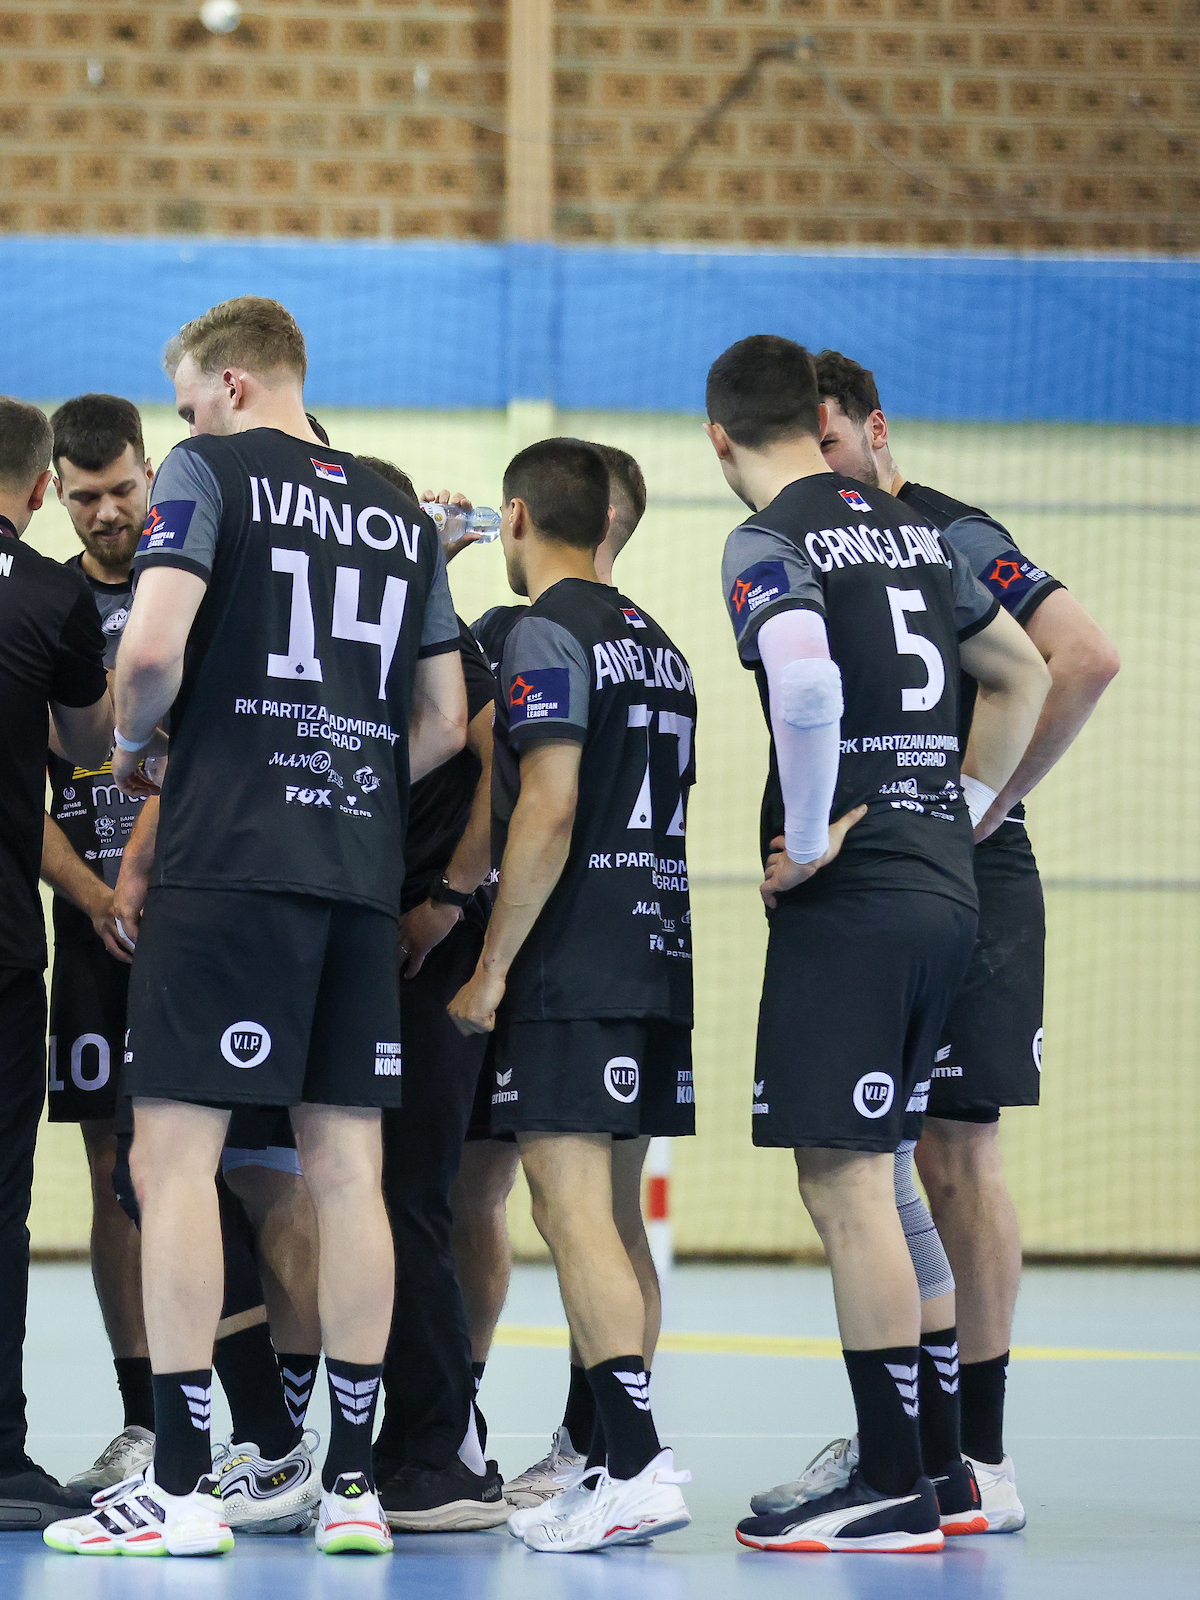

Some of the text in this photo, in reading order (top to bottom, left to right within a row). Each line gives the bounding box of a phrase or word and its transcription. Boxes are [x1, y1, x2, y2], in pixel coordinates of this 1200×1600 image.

[250, 475, 421, 564] IVANOV
[266, 547, 409, 701] 14
[886, 585, 946, 712] 5
[235, 698, 258, 715] RK
[261, 699, 328, 723] PARTIZA
[526, 702, 559, 711] EUROPEAN
[526, 709, 549, 719] LEAGUE
[296, 721, 362, 752] BEORAD
[862, 734, 925, 753] PARTIZAN
[896, 751, 947, 767] BEOGRAD
[588, 853, 612, 869] RK
[232, 1033, 260, 1052] V.I.P.
[611, 1069, 636, 1086] V.I.P.
[864, 1084, 889, 1102] V.I.P.
